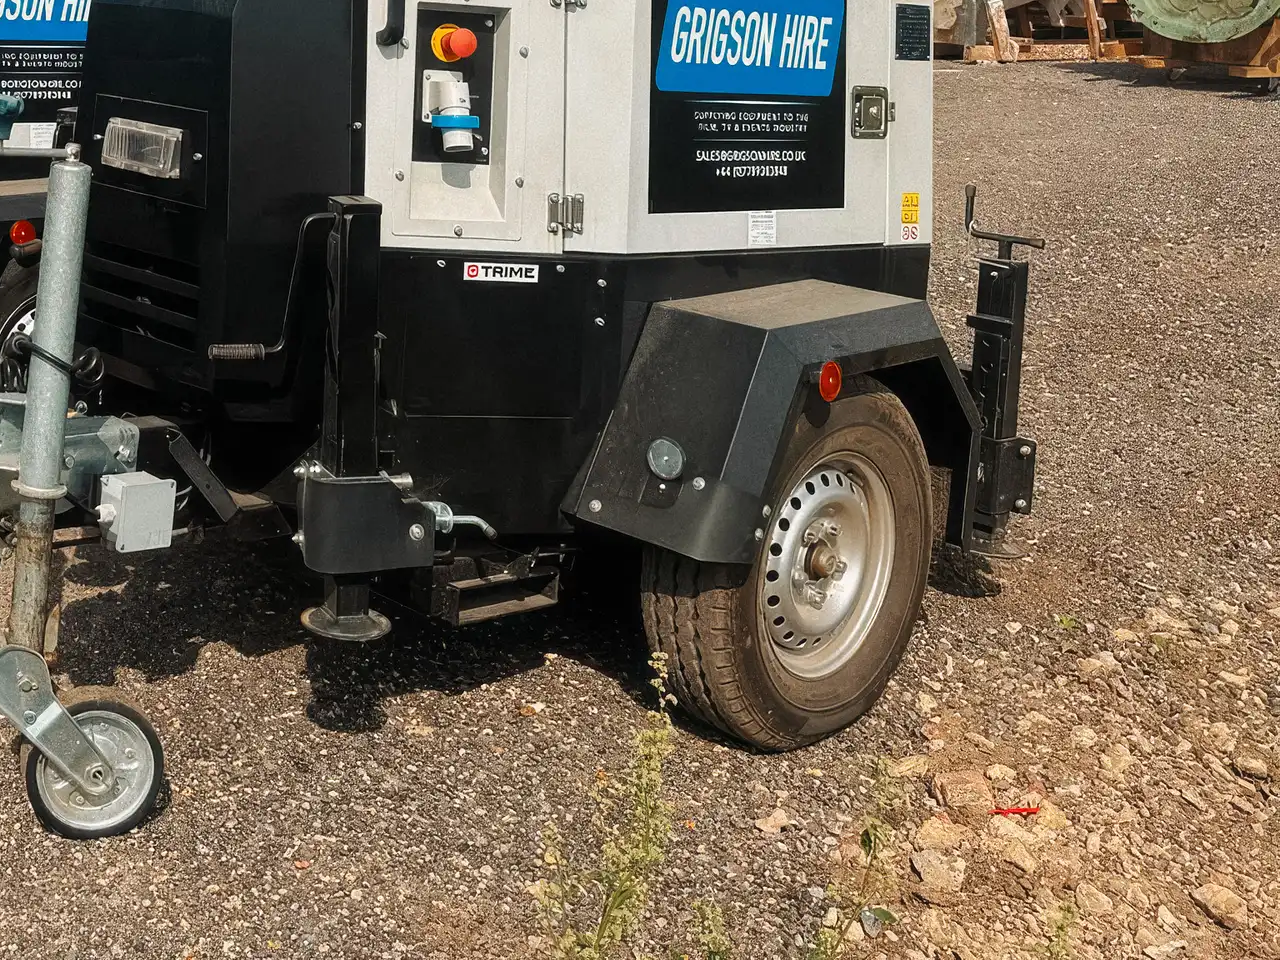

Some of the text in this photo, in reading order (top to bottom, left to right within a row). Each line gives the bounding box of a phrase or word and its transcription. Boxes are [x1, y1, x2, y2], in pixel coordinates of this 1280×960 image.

[671, 6, 777, 67] GRIGSON
[778, 14, 833, 70] HIRE
[481, 266, 535, 279] TRIME
